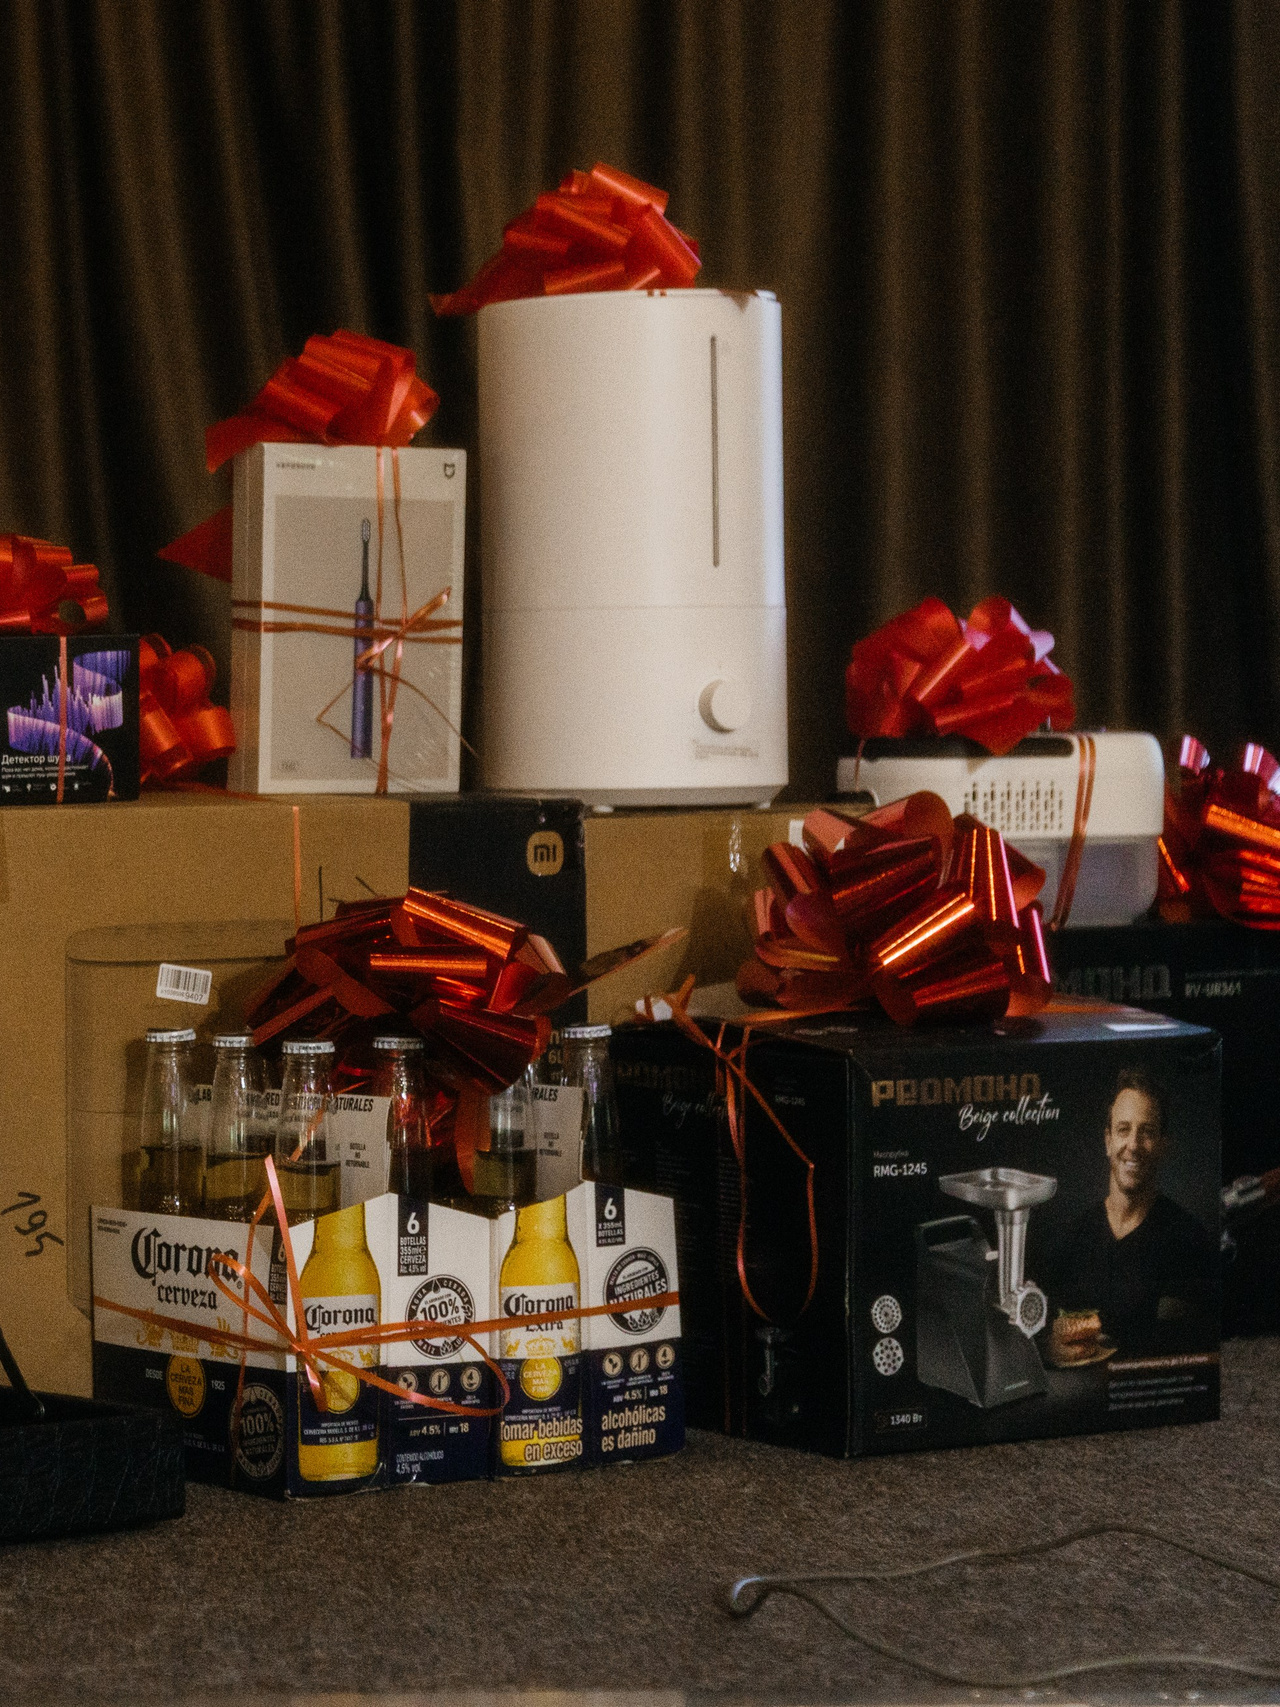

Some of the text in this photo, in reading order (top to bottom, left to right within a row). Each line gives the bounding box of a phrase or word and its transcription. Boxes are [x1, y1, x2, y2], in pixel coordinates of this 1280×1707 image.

[1, 754, 71, 765] Детектор шуа
[958, 1092, 1061, 1142] Beige collection
[873, 1162, 928, 1178] RMG-1245
[604, 1197, 617, 1220] 6
[407, 1212, 420, 1235] 6
[598, 1228, 624, 1238] BOTELLAS
[400, 1237, 426, 1246] BOTELLAS
[131, 1227, 240, 1286] Corona
[400, 1255, 426, 1264] CERVEZA
[614, 1270, 660, 1296] INGREDIENTES
[157, 1284, 218, 1310] cerveza
[504, 1293, 574, 1317] Corona
[305, 1304, 377, 1333] Corona
[420, 1297, 460, 1321] 100%
[181, 1364, 191, 1373] LA
[523, 1370, 558, 1379] CERVEZA
[170, 1375, 202, 1386] CERVEZA
[211, 1380, 226, 1391] 1925
[239, 1412, 275, 1436] 100%
[459, 1422, 469, 1433] 18
[501, 1416, 583, 1440] Tomar bebidas
[601, 1405, 666, 1431] alcohólicas
[890, 1414, 910, 1425] 1340
[524, 1440, 583, 1461] en exceso
[601, 1426, 656, 1452] es dañino
